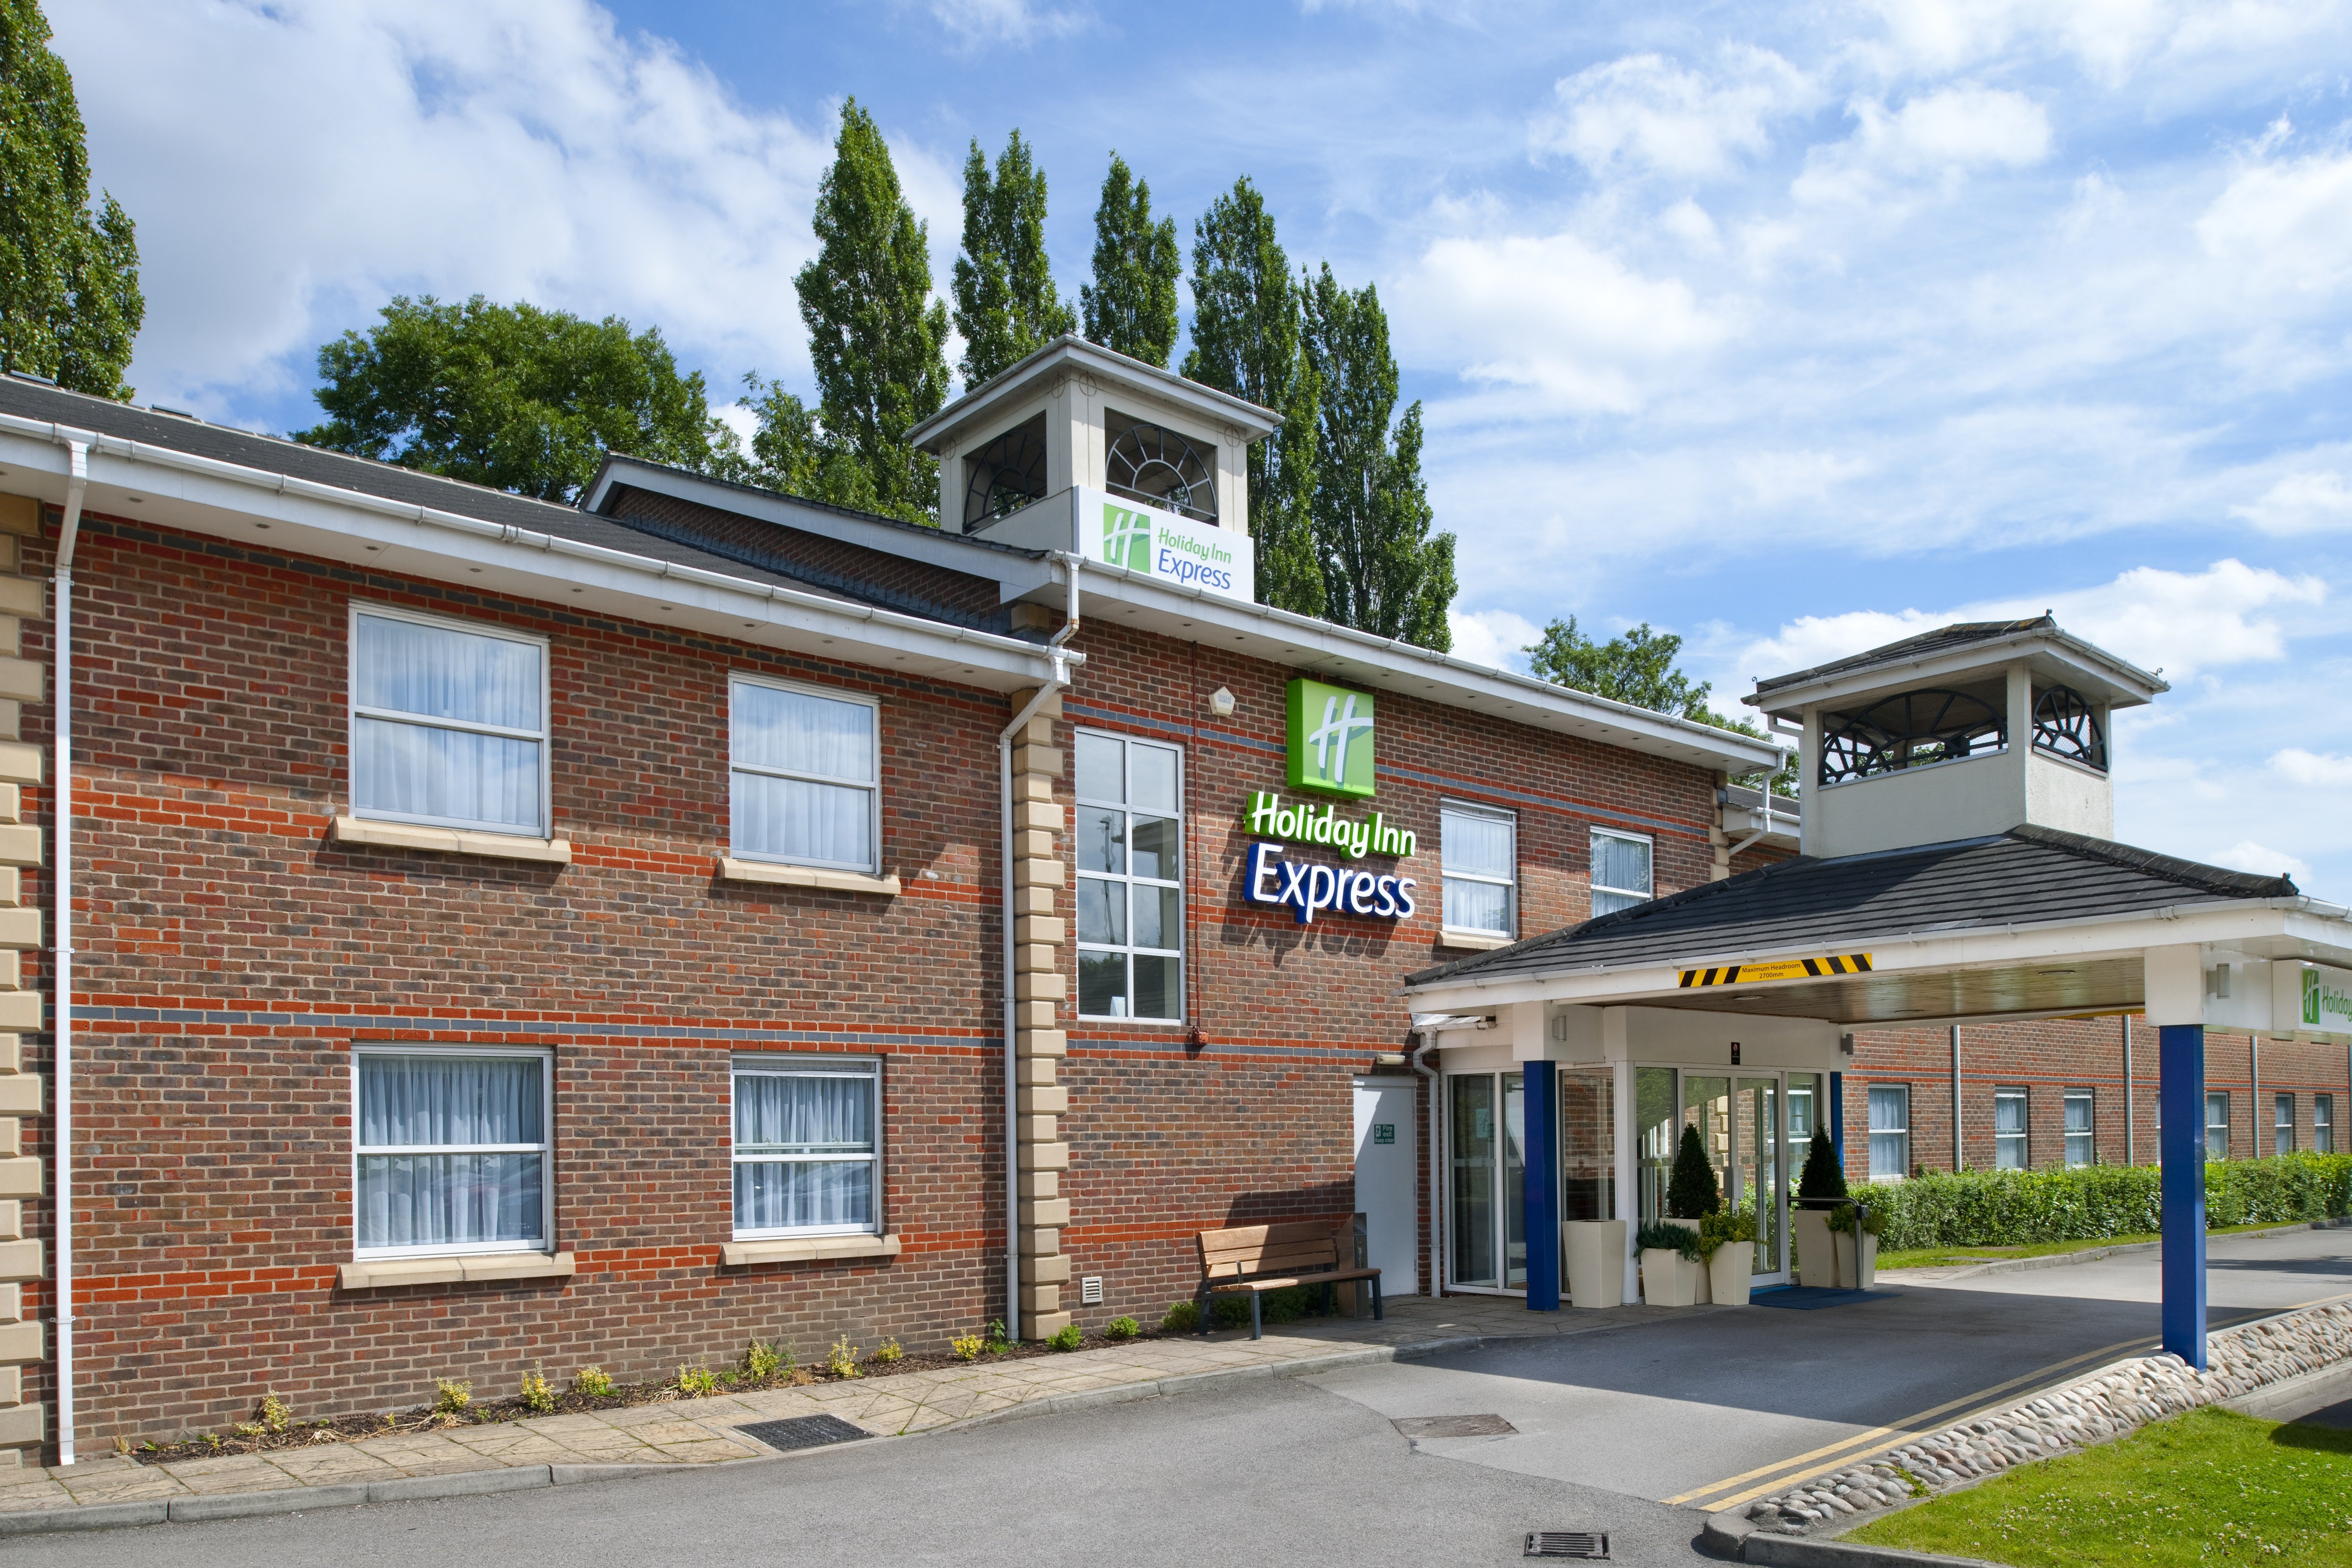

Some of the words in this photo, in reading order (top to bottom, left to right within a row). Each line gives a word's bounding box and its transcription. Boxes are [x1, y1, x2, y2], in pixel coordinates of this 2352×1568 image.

[1158, 527, 1209, 561] Holiday
[1211, 543, 1232, 564] Inn
[1158, 548, 1231, 590] Express
[1249, 791, 1370, 858] Holiday
[1374, 812, 1416, 856] Inn
[1252, 842, 1417, 923] Express
